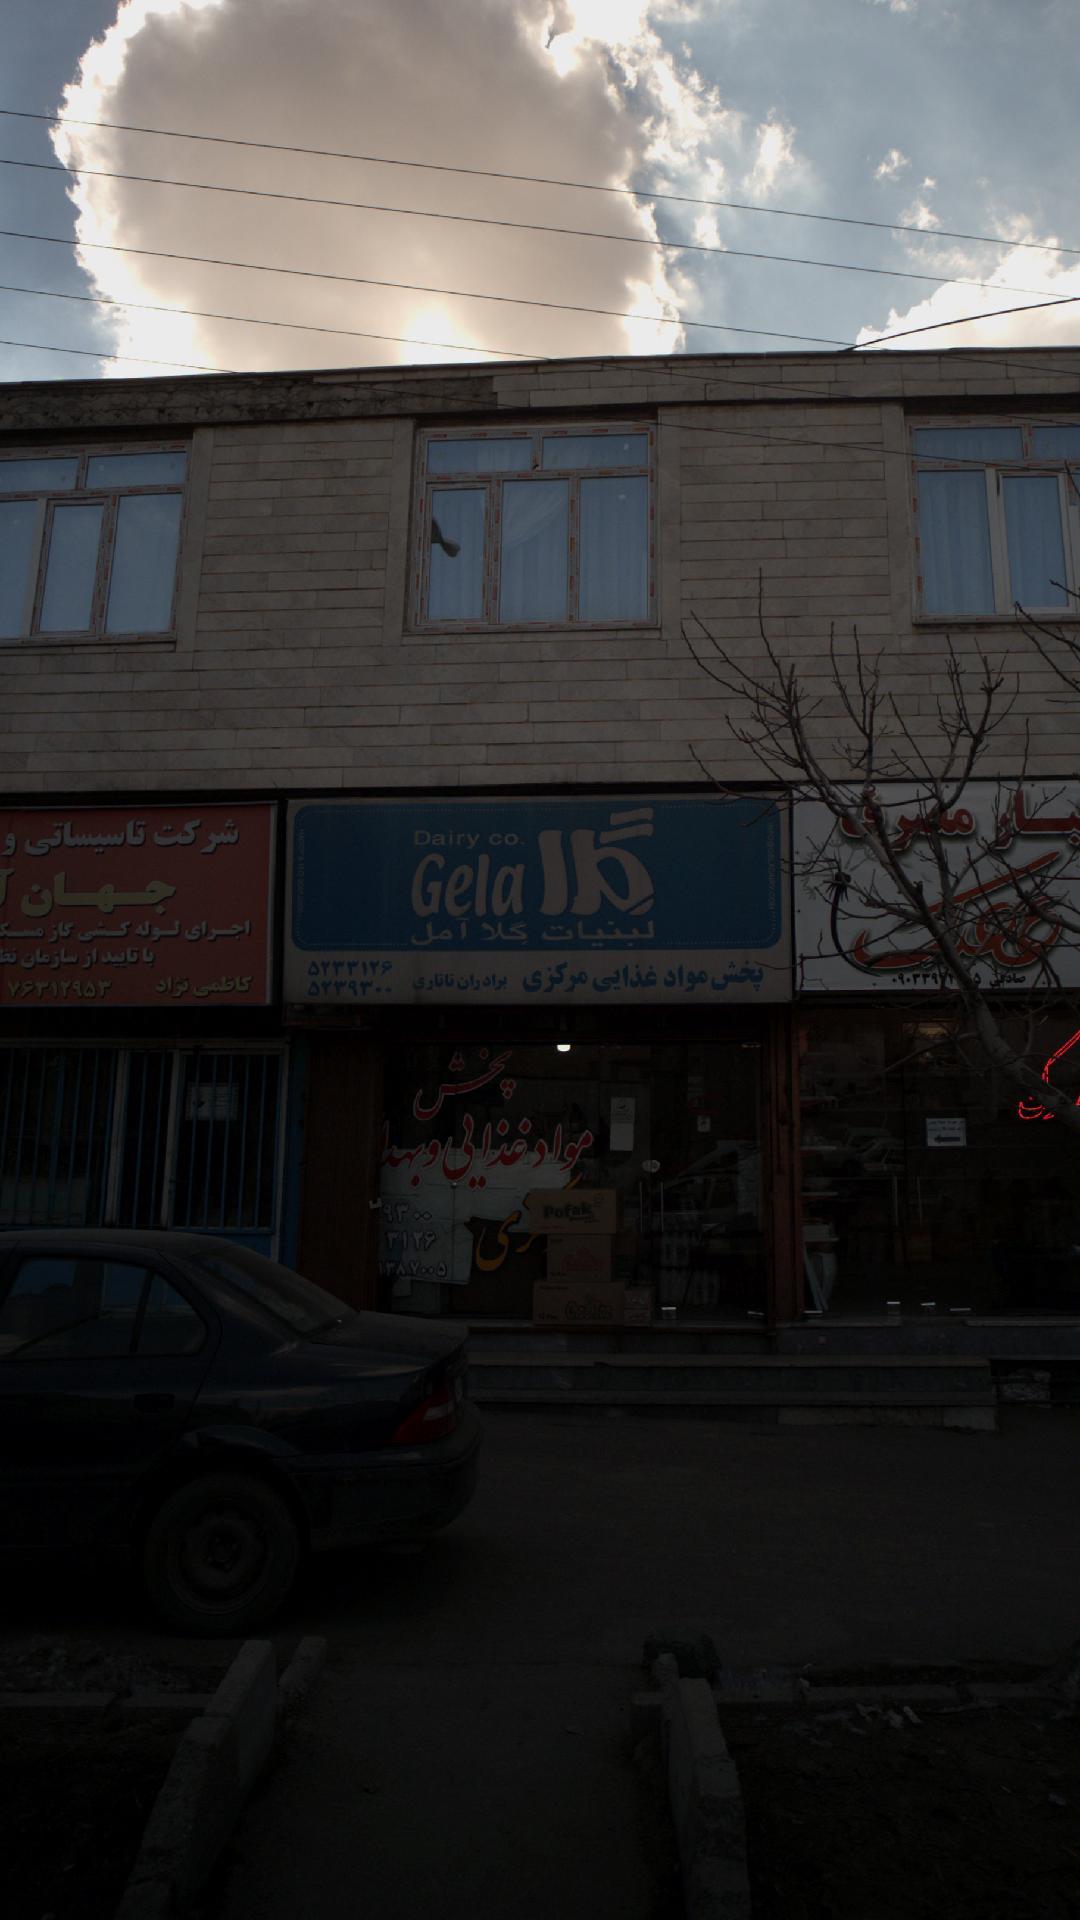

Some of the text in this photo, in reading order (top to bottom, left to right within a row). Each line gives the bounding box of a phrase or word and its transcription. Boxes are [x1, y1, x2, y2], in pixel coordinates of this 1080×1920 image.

[0, 818, 240, 856] شرکت تاسیساتی و
[412, 829, 526, 849] Dairy co.
[20, 871, 177, 918] جهان
[410, 852, 526, 917] Gela
[48, 920, 76, 944] گاز
[78, 920, 131, 943] کشی
[135, 920, 181, 942] لوله
[185, 919, 252, 942] اجرای
[410, 918, 470, 946] آمل
[541, 919, 657, 948] لبنیات
[20, 946, 79, 970] سازمان
[82, 946, 98, 970] از
[101, 946, 141, 969] تایید
[142, 946, 156, 968] با
[155, 975, 254, 998] کاظمی نژاد
[457, 973, 508, 992] برادران
[522, 960, 764, 993] پخش مواد غذایی مرکزی
[412, 1046, 516, 1120] پخش
[442, 1111, 532, 1192] غذایی
[532, 1122, 594, 1174] مواد
